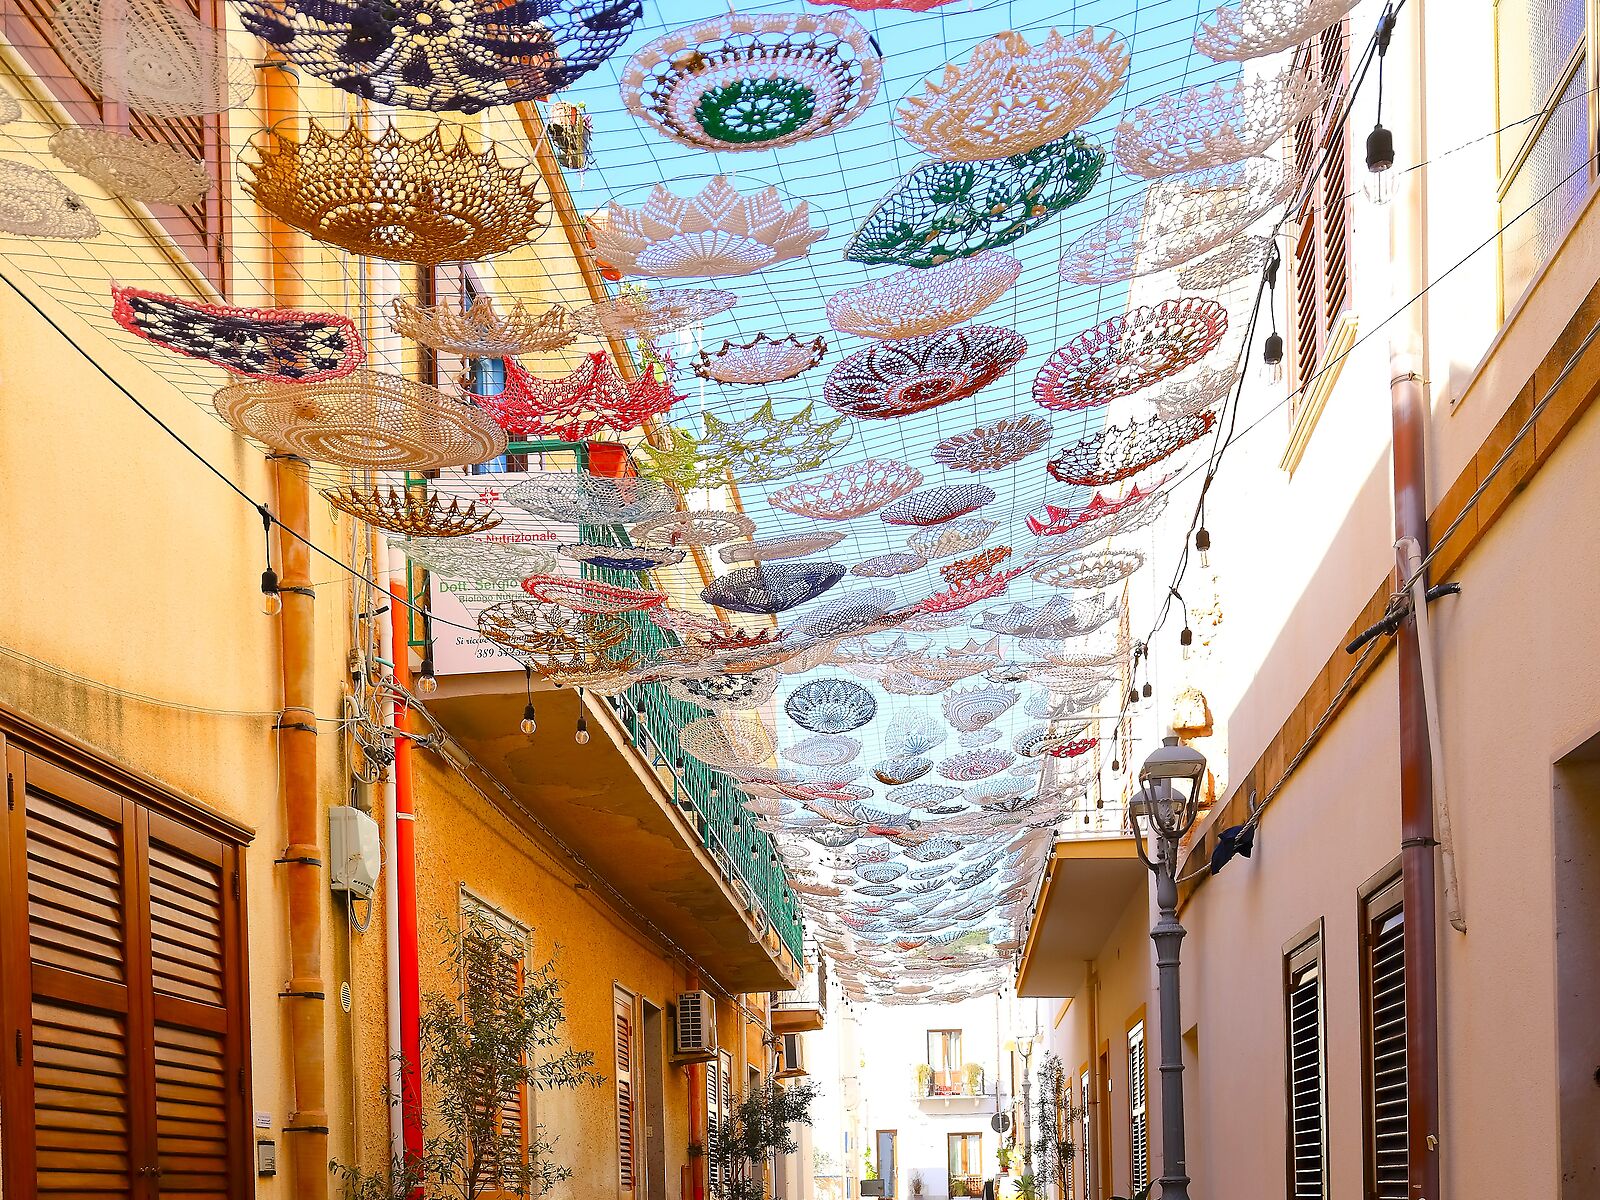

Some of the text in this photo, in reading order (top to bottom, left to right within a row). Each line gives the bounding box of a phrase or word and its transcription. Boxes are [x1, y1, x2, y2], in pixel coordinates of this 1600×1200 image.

[486, 530, 557, 544] Nutrizionale
[440, 579, 518, 592] Dott. Sergio
[459, 592, 534, 603] Biologo Nutrizio
[456, 636, 489, 646] Si riceve
[476, 648, 494, 659] 389
